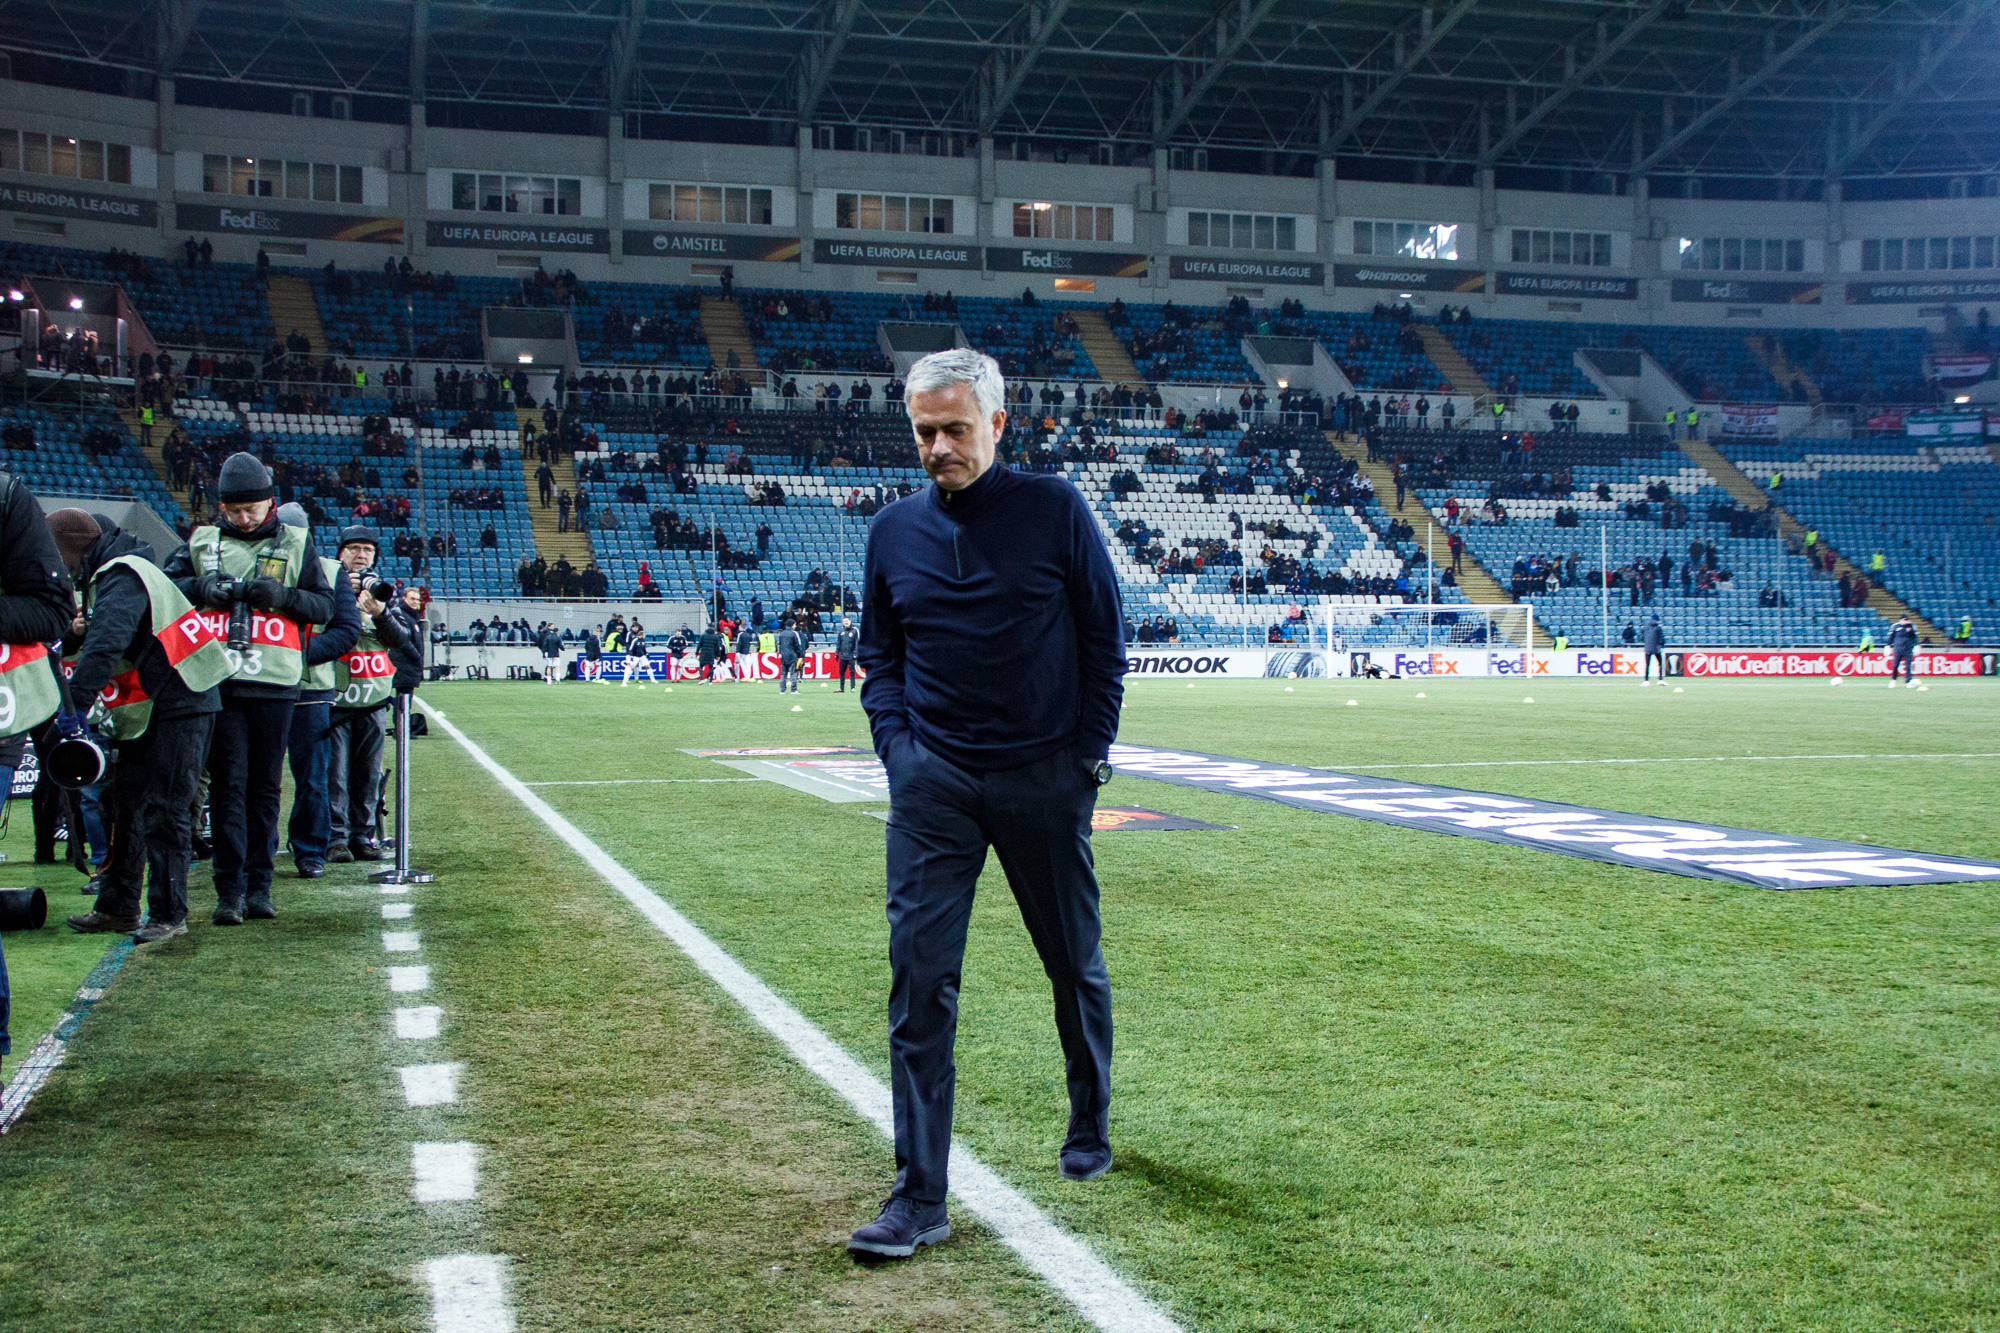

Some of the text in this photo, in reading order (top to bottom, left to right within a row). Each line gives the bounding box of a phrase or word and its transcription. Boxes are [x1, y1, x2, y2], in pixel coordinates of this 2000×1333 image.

[16, 189, 78, 209] EUROPA
[81, 198, 140, 216] LEAGUE
[220, 208, 281, 231] FedEx
[443, 227, 594, 245] UEFA EUROPA LEAGUE
[670, 236, 726, 252] AMSTEL
[830, 244, 968, 262] UEFA EUROPA LEAGUE
[1022, 250, 1072, 269] FedEx
[1184, 262, 1312, 279] UEFA EUROPA LEAGUE
[1509, 277, 1628, 293] UEFA EUROPA LEAGUE
[1395, 653, 1459, 675] FedEx
[1577, 653, 1639, 675] FedEx
[1709, 655, 1830, 674] UniCredit Bank
[1933, 655, 1978, 674] Bank
